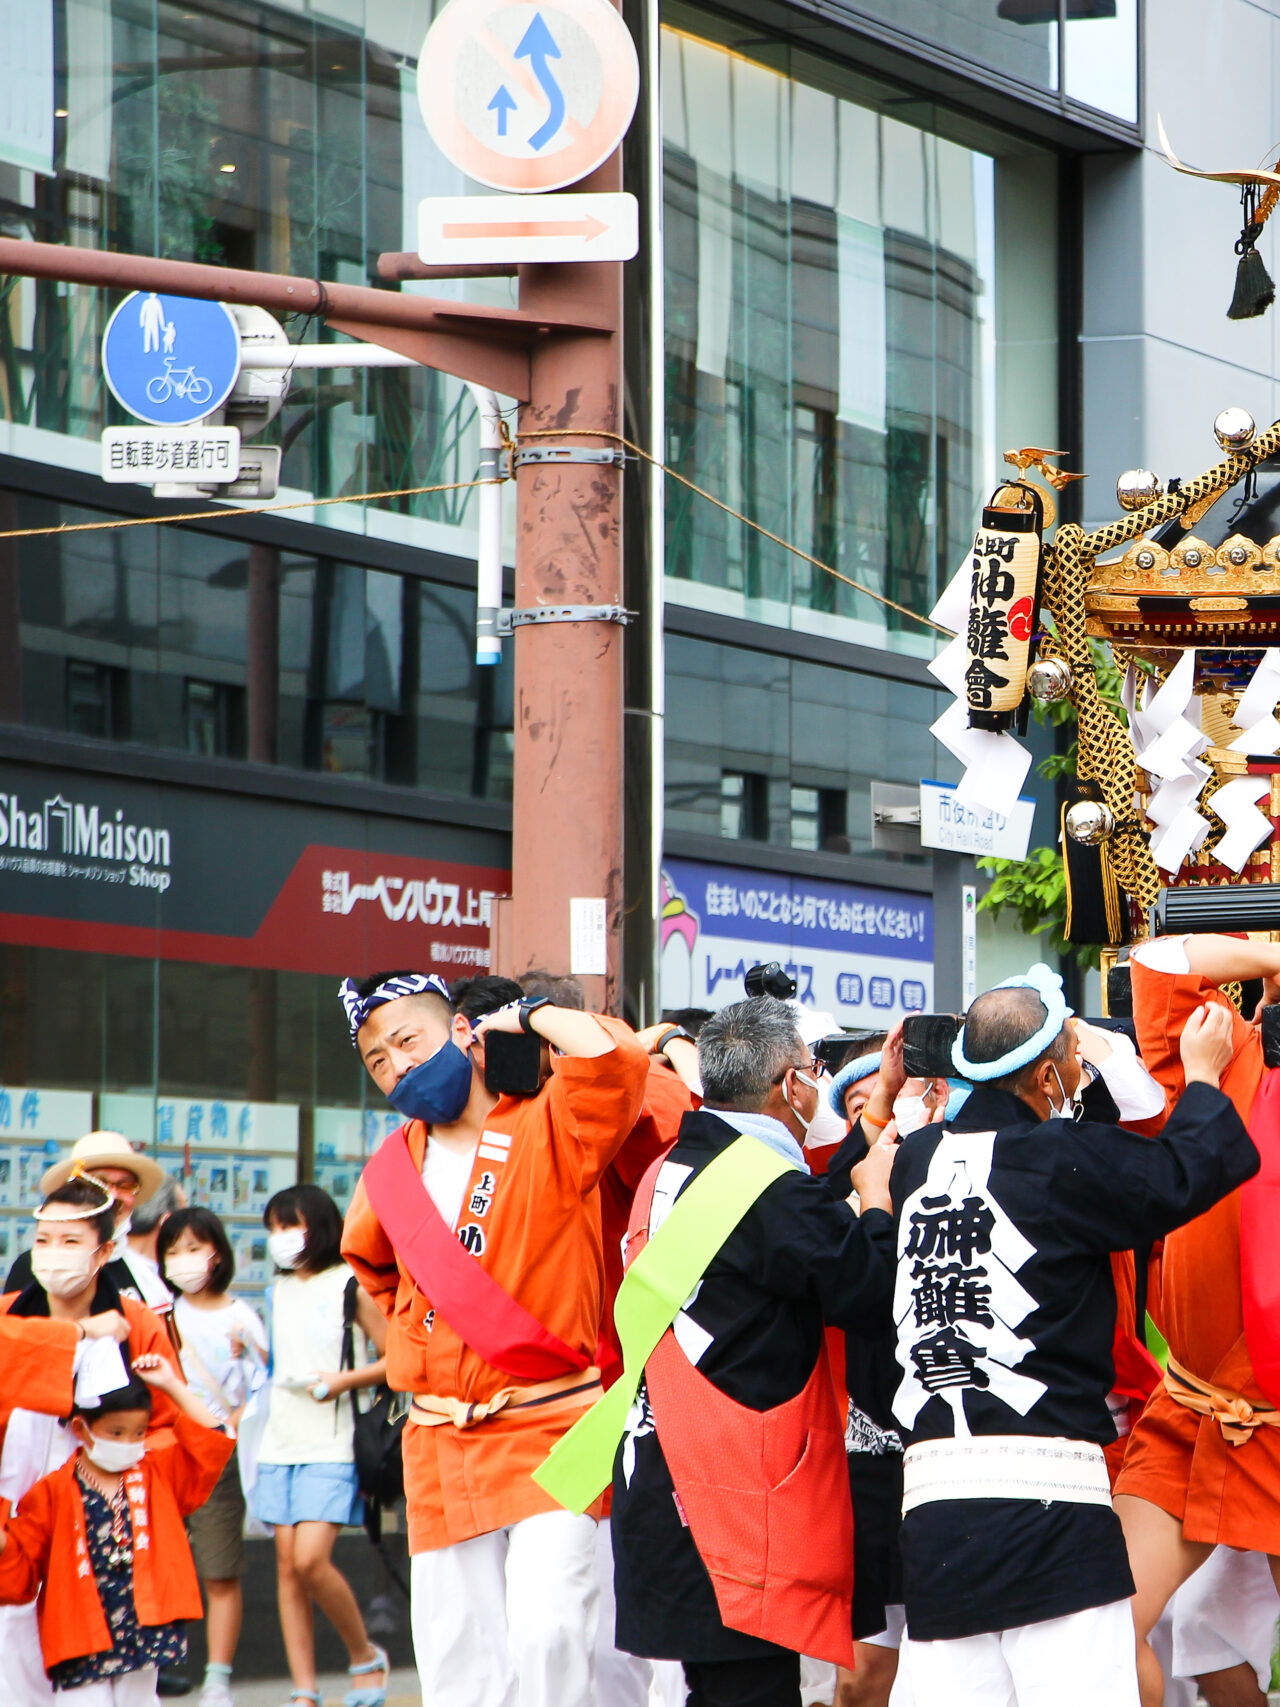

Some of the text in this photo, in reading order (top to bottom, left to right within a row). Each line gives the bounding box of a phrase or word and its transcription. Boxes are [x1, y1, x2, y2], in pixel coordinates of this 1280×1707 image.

[111, 440, 231, 470] 自転車歩道通行可
[74, 803, 171, 867] Maison
[938, 826, 993, 851] City Hall Road
[129, 863, 171, 894] Shop
[470, 1173, 493, 1215] 上町
